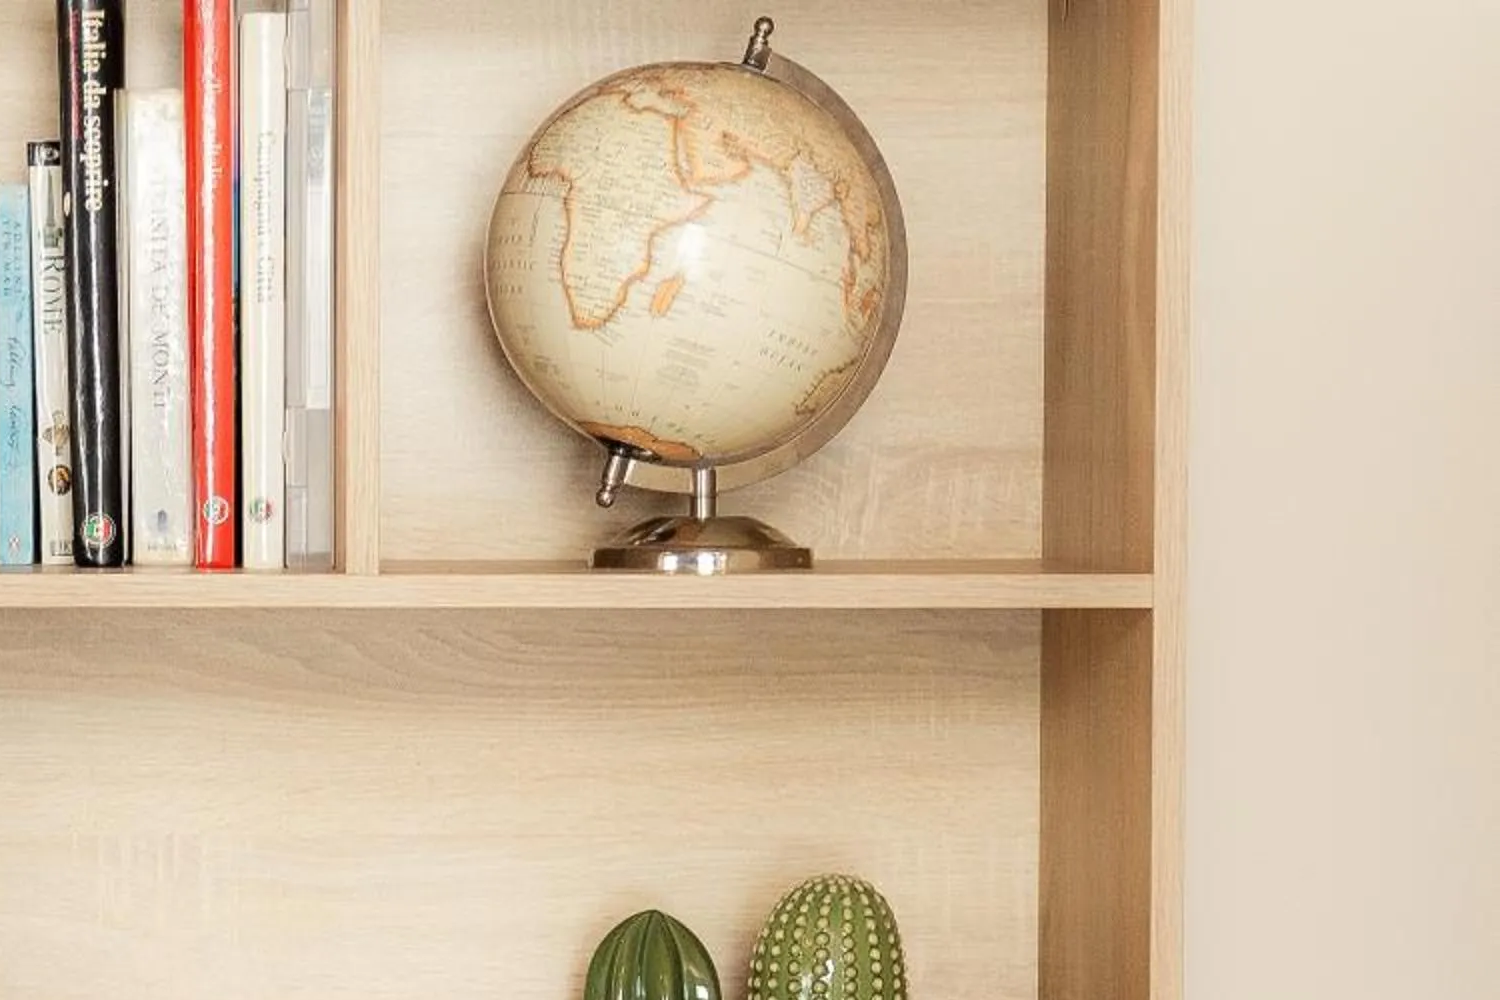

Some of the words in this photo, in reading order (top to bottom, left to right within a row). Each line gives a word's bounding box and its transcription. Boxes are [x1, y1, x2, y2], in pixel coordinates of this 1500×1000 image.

[82, 10, 107, 73] Italia
[83, 80, 107, 110] da
[80, 115, 108, 211] scoprire
[43, 256, 67, 334] ROME
